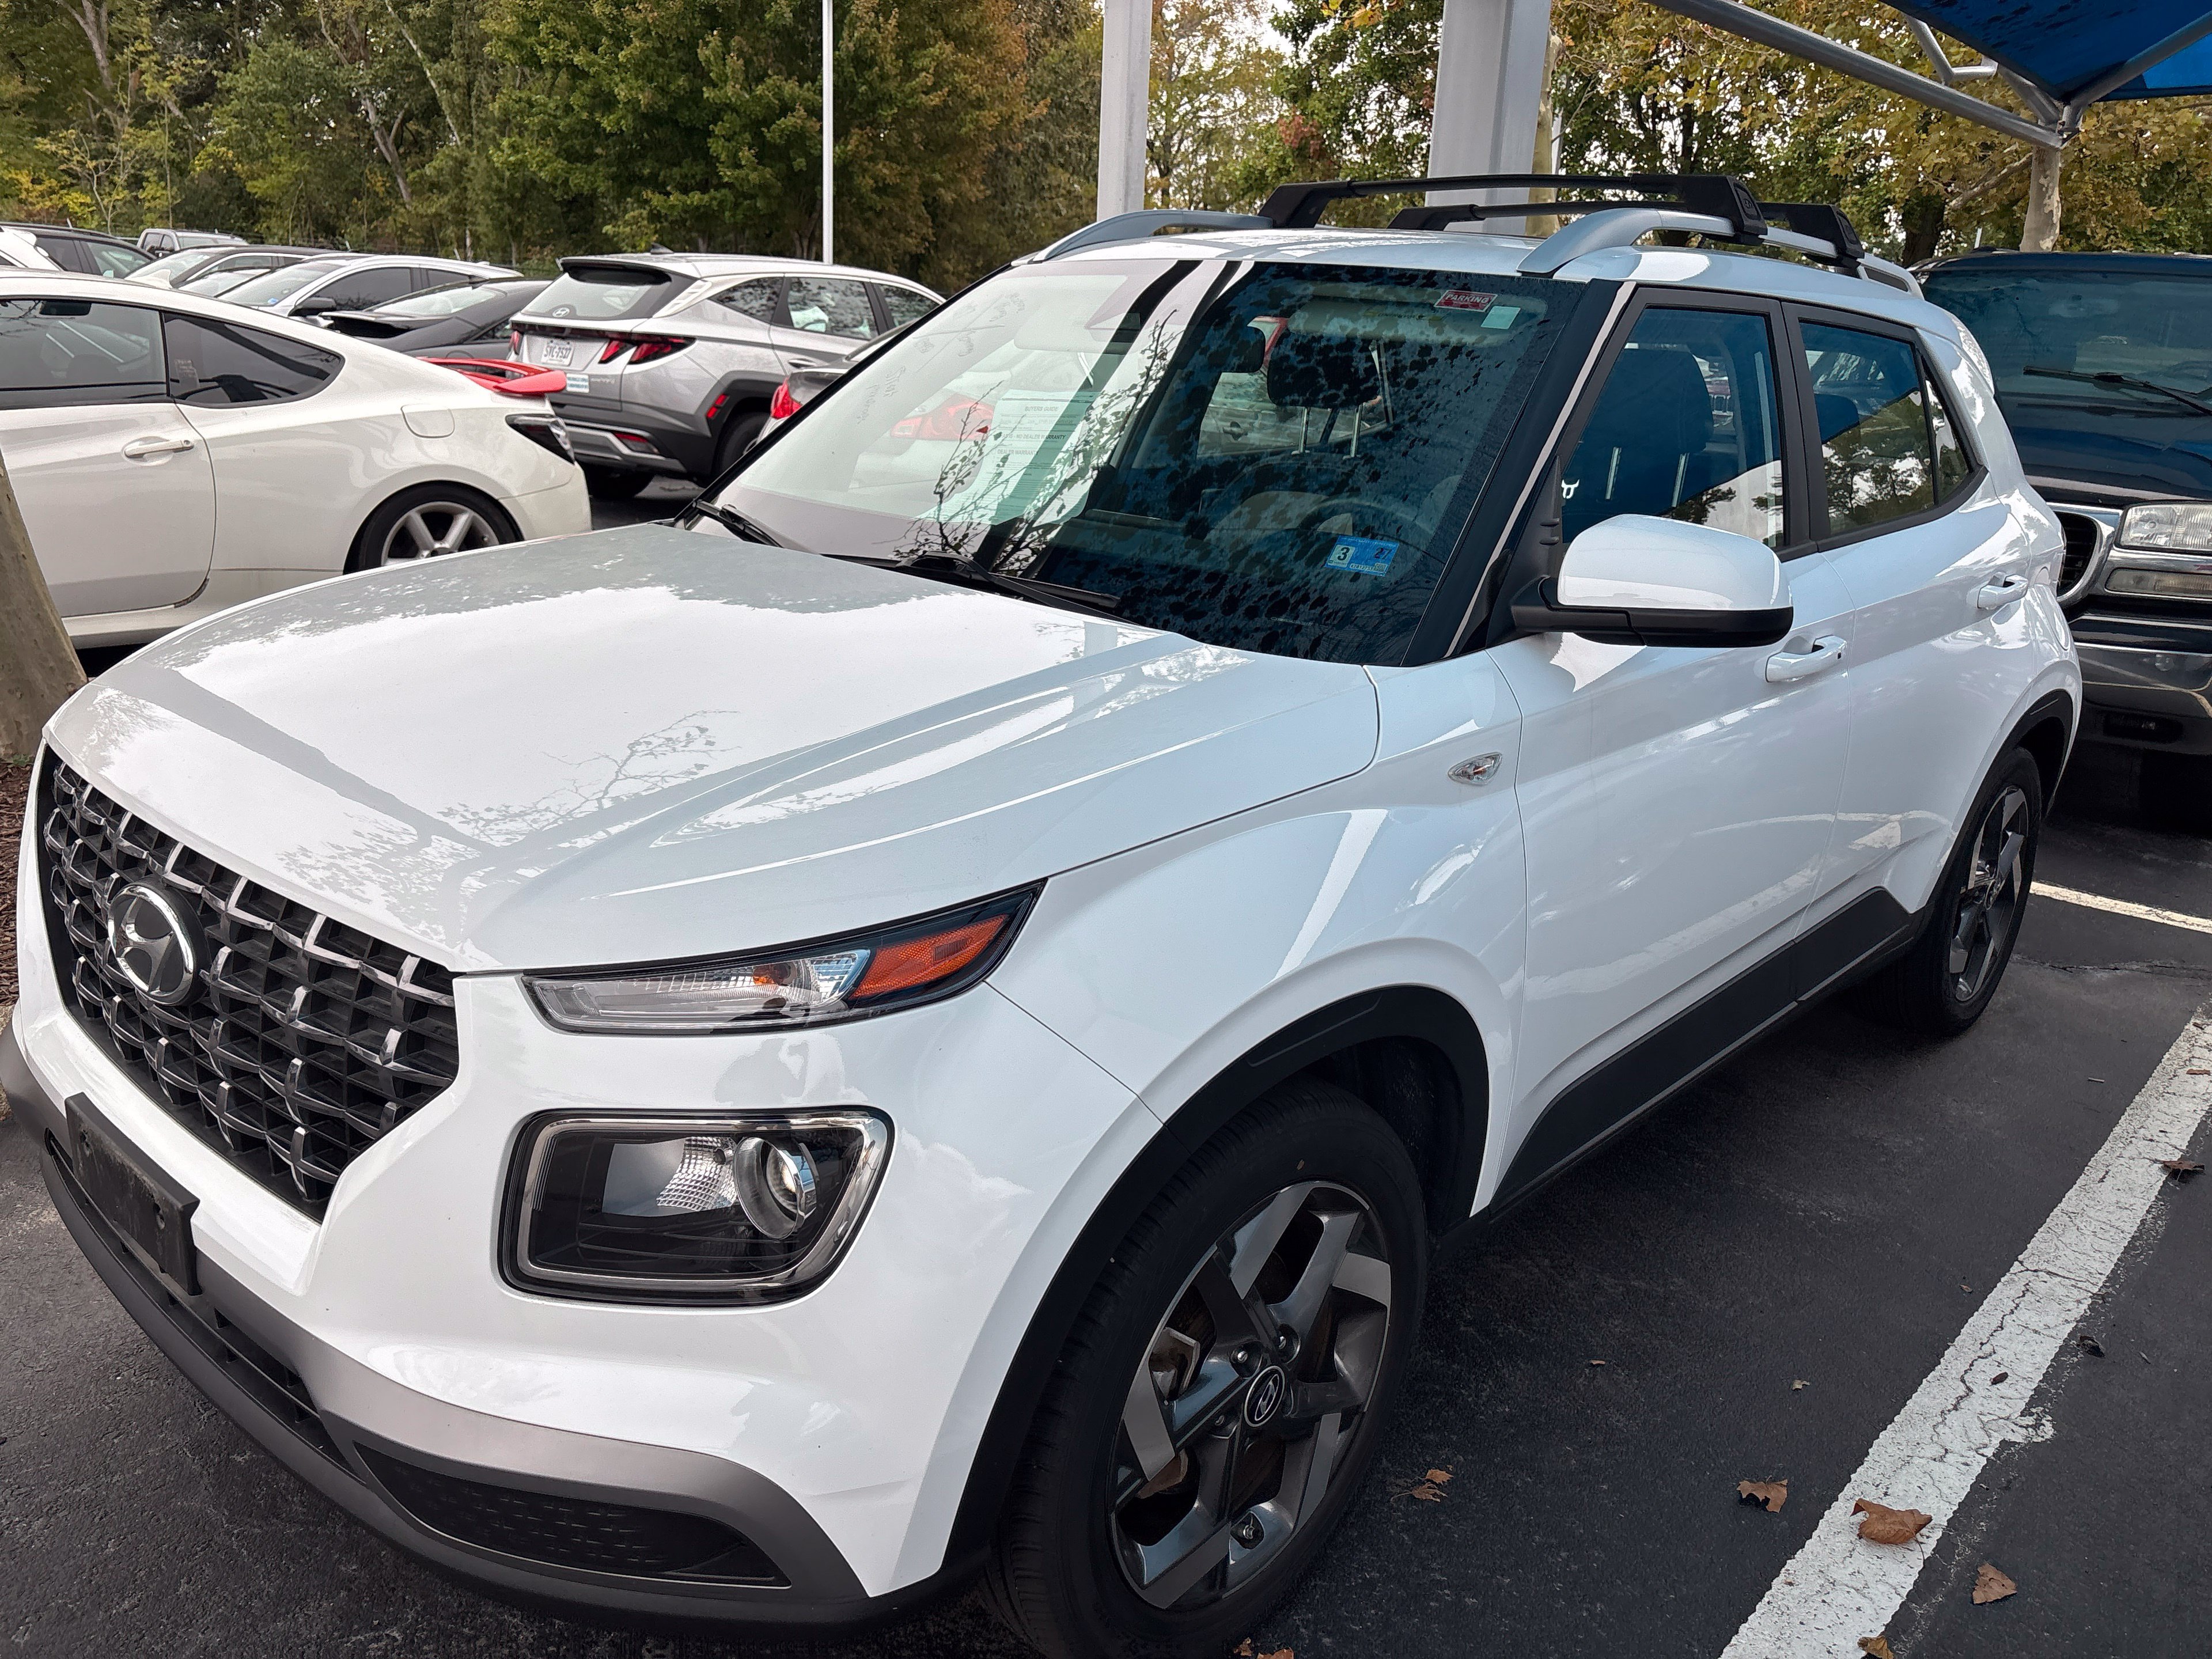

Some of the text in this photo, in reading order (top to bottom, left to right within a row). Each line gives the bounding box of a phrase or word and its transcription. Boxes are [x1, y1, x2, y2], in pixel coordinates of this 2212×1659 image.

[1445, 294, 1489, 304] PARKING
[1337, 547, 1392, 561] 3 27
